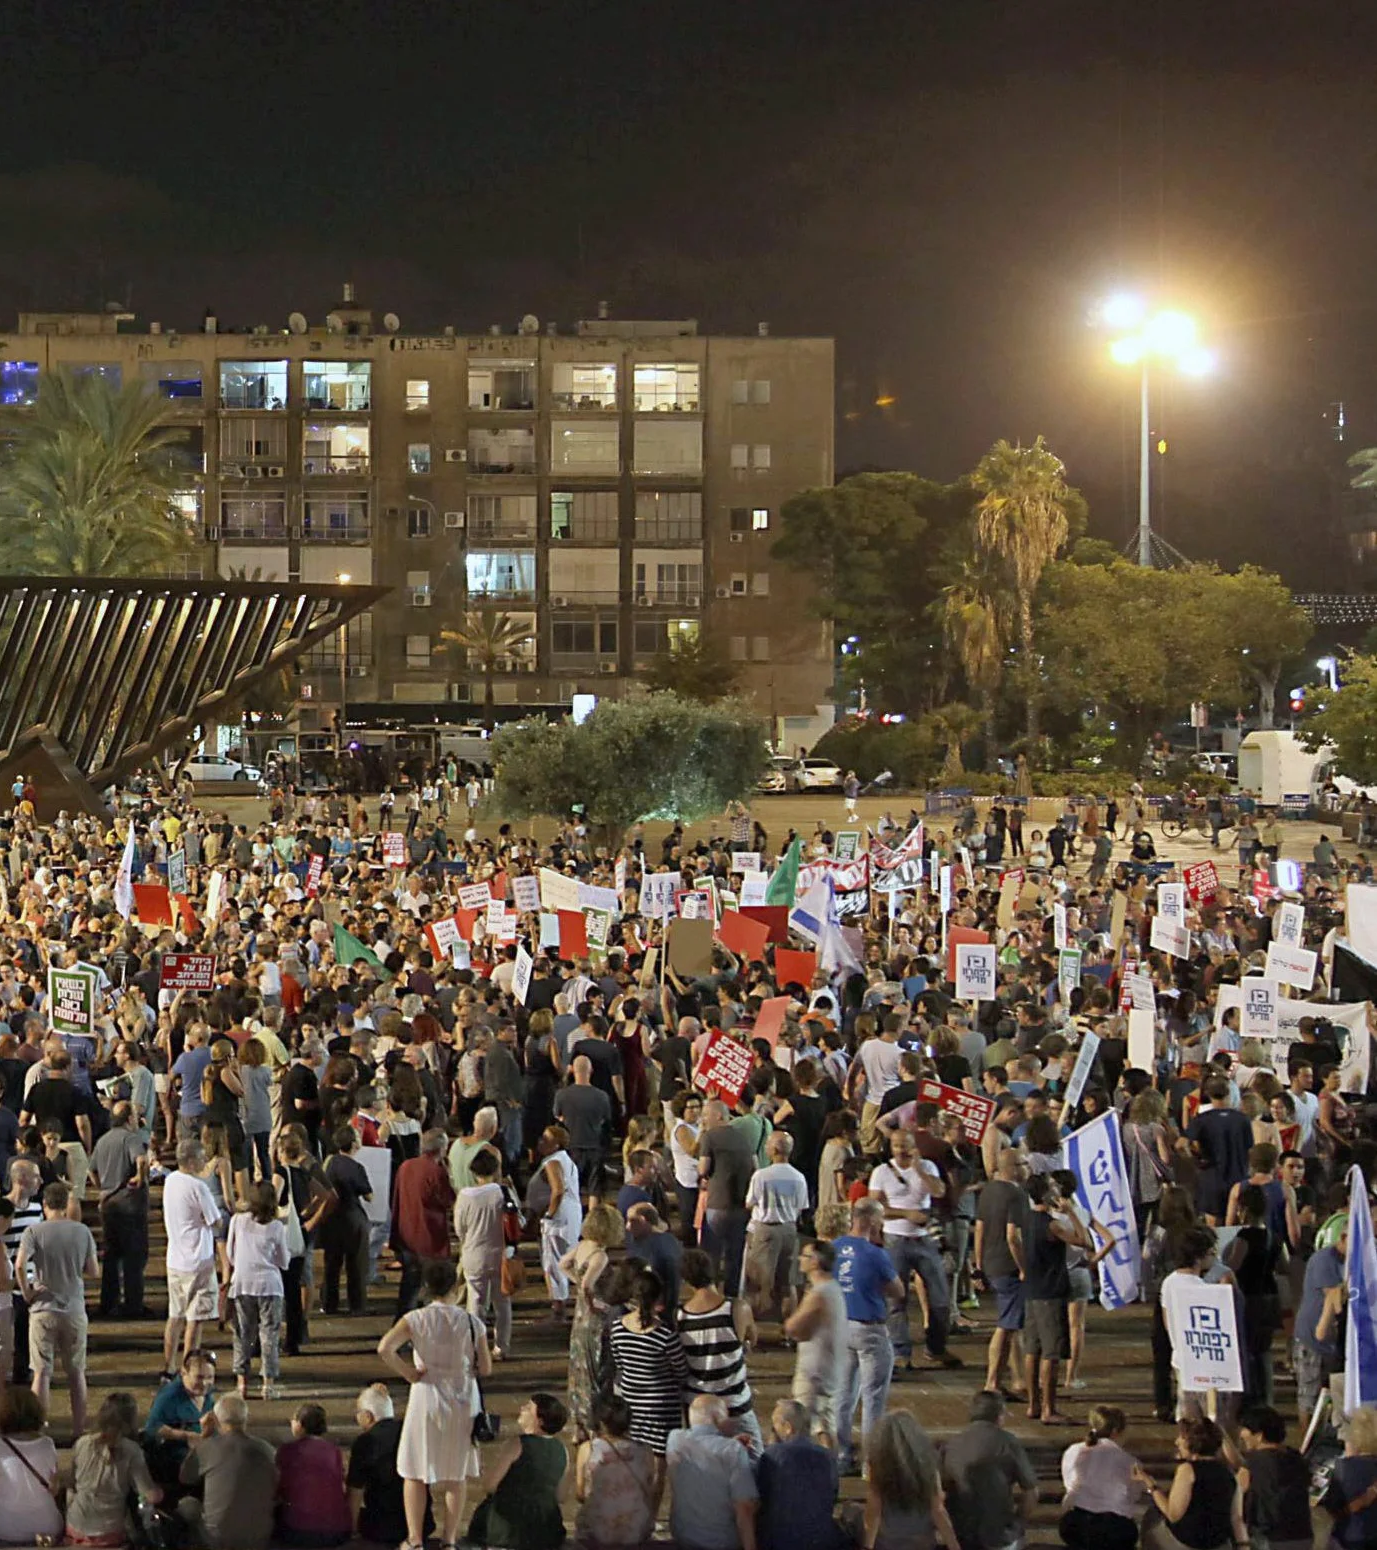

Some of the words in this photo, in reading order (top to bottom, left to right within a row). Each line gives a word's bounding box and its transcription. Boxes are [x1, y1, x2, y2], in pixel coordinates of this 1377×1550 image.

[182, 963, 196, 971] על
[189, 957, 212, 965] ביחד
[198, 964, 211, 972] נגן
[163, 978, 210, 987] הדמוקרטי
[176, 971, 211, 979] המרחב
[55, 976, 86, 990] כשאין
[58, 988, 84, 1001] שלום
[61, 998, 81, 1011] באה
[54, 1005, 88, 1024] מלחמה
[721, 1035, 752, 1058] יהודים
[707, 1047, 747, 1078] מסרבים
[714, 1041, 750, 1069] וערבים
[714, 1062, 743, 1085] להיות
[707, 1069, 739, 1095] אויבים
[946, 1099, 966, 1114] על
[957, 1094, 988, 1112] ביחד
[967, 1108, 987, 1121] נגן
[1184, 1330, 1231, 1348] לפתרון
[1191, 1345, 1225, 1362] מדיני
